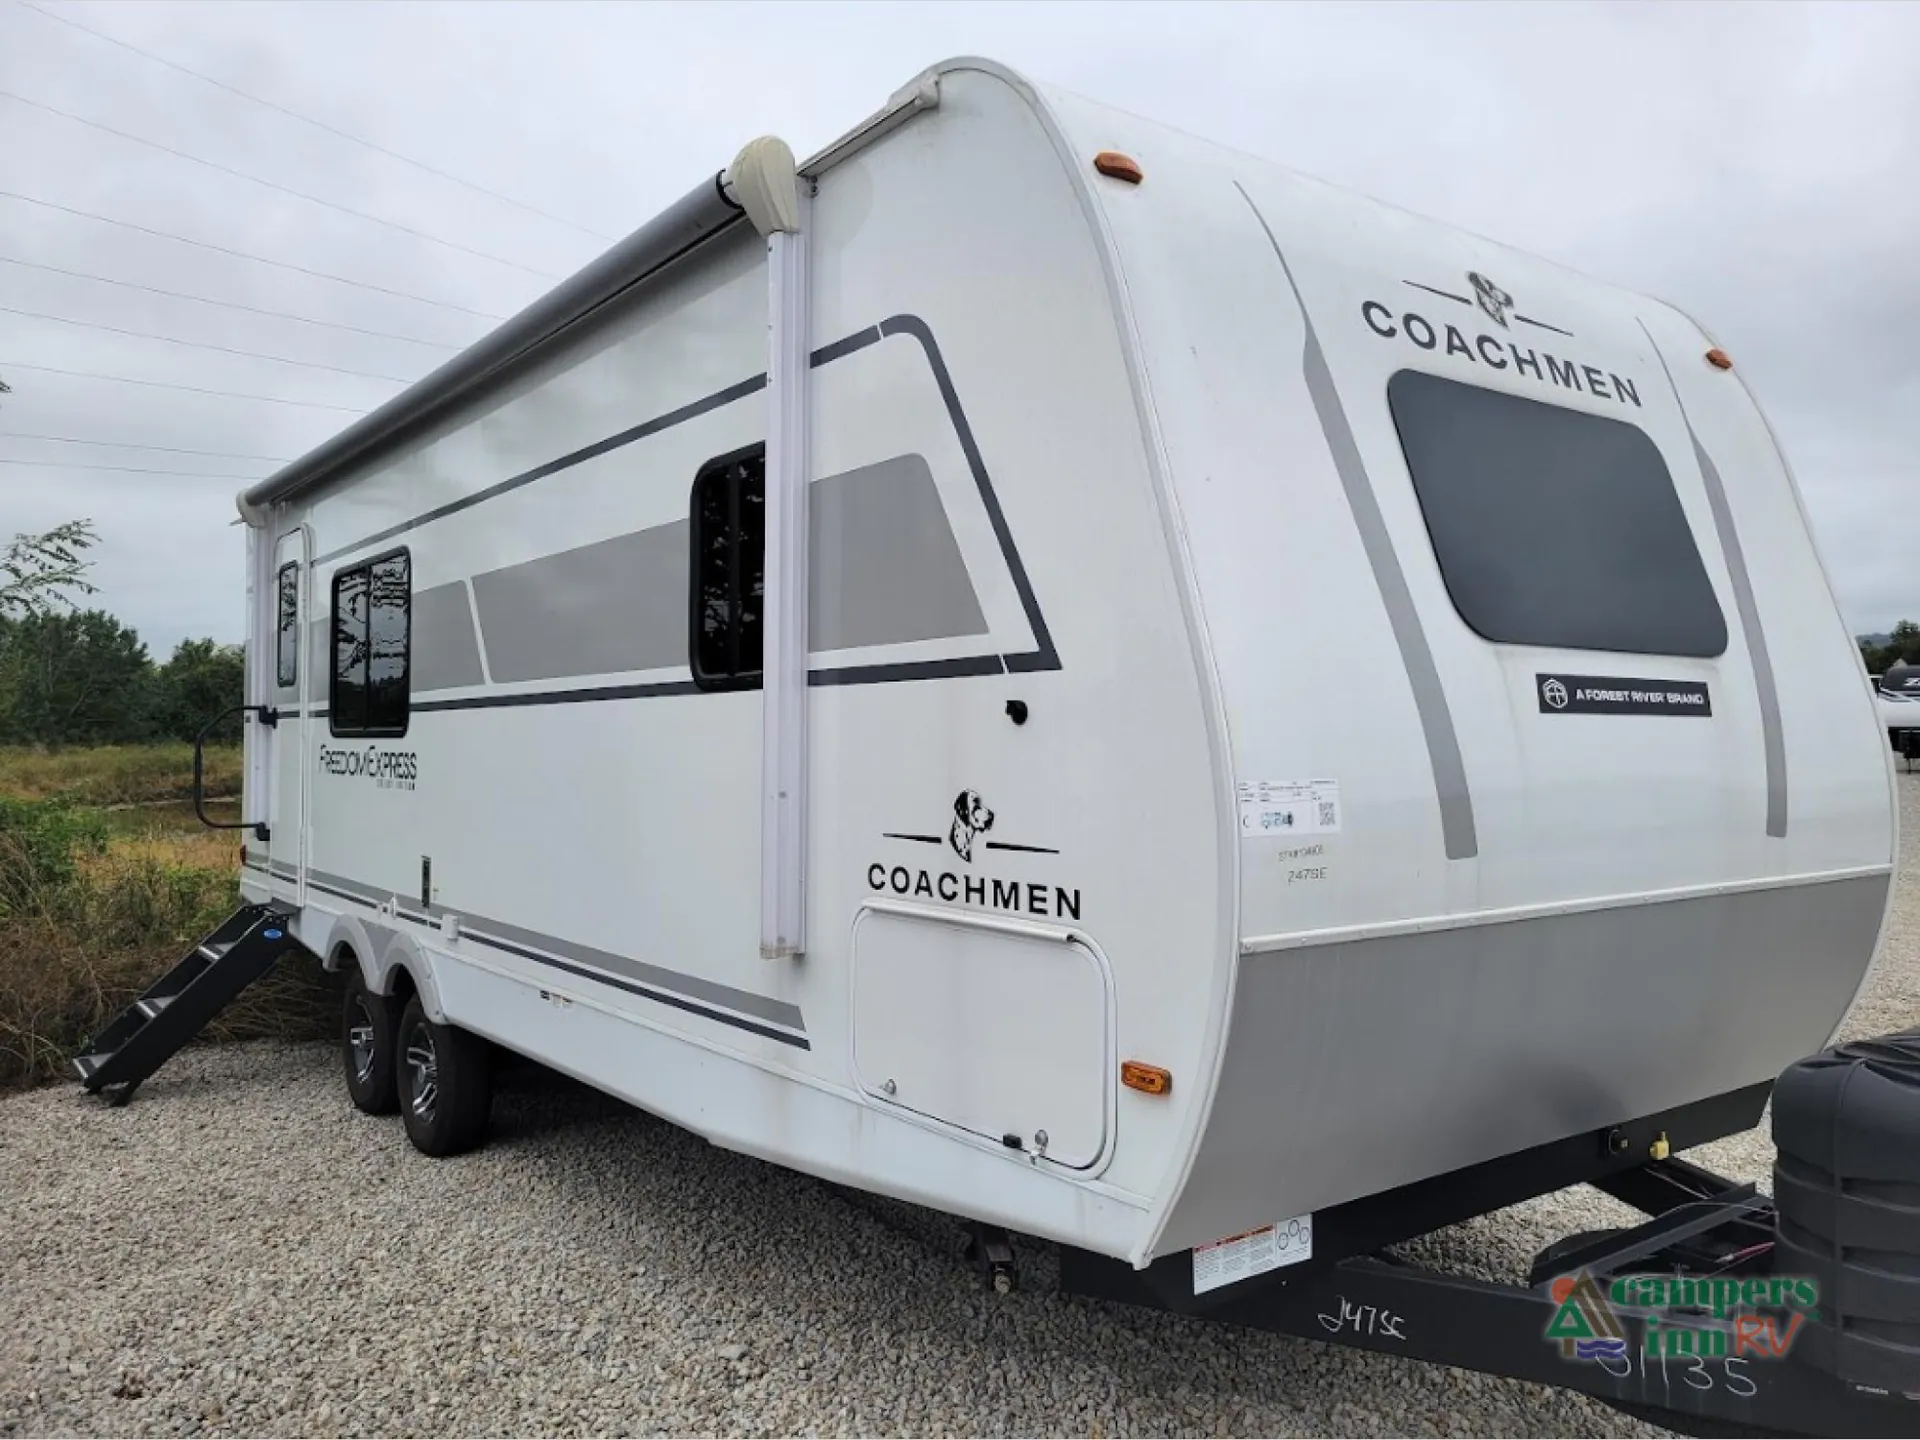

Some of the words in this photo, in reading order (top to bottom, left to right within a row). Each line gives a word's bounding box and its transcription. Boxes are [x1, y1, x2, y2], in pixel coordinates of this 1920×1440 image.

[1362, 300, 1642, 408] COACHMEN
[1576, 688, 1585, 700] A
[1585, 689, 1630, 702] FOREST
[1631, 690, 1665, 703] RIVER
[1666, 692, 1705, 705] BRAND
[867, 862, 1081, 921] COACHMEN
